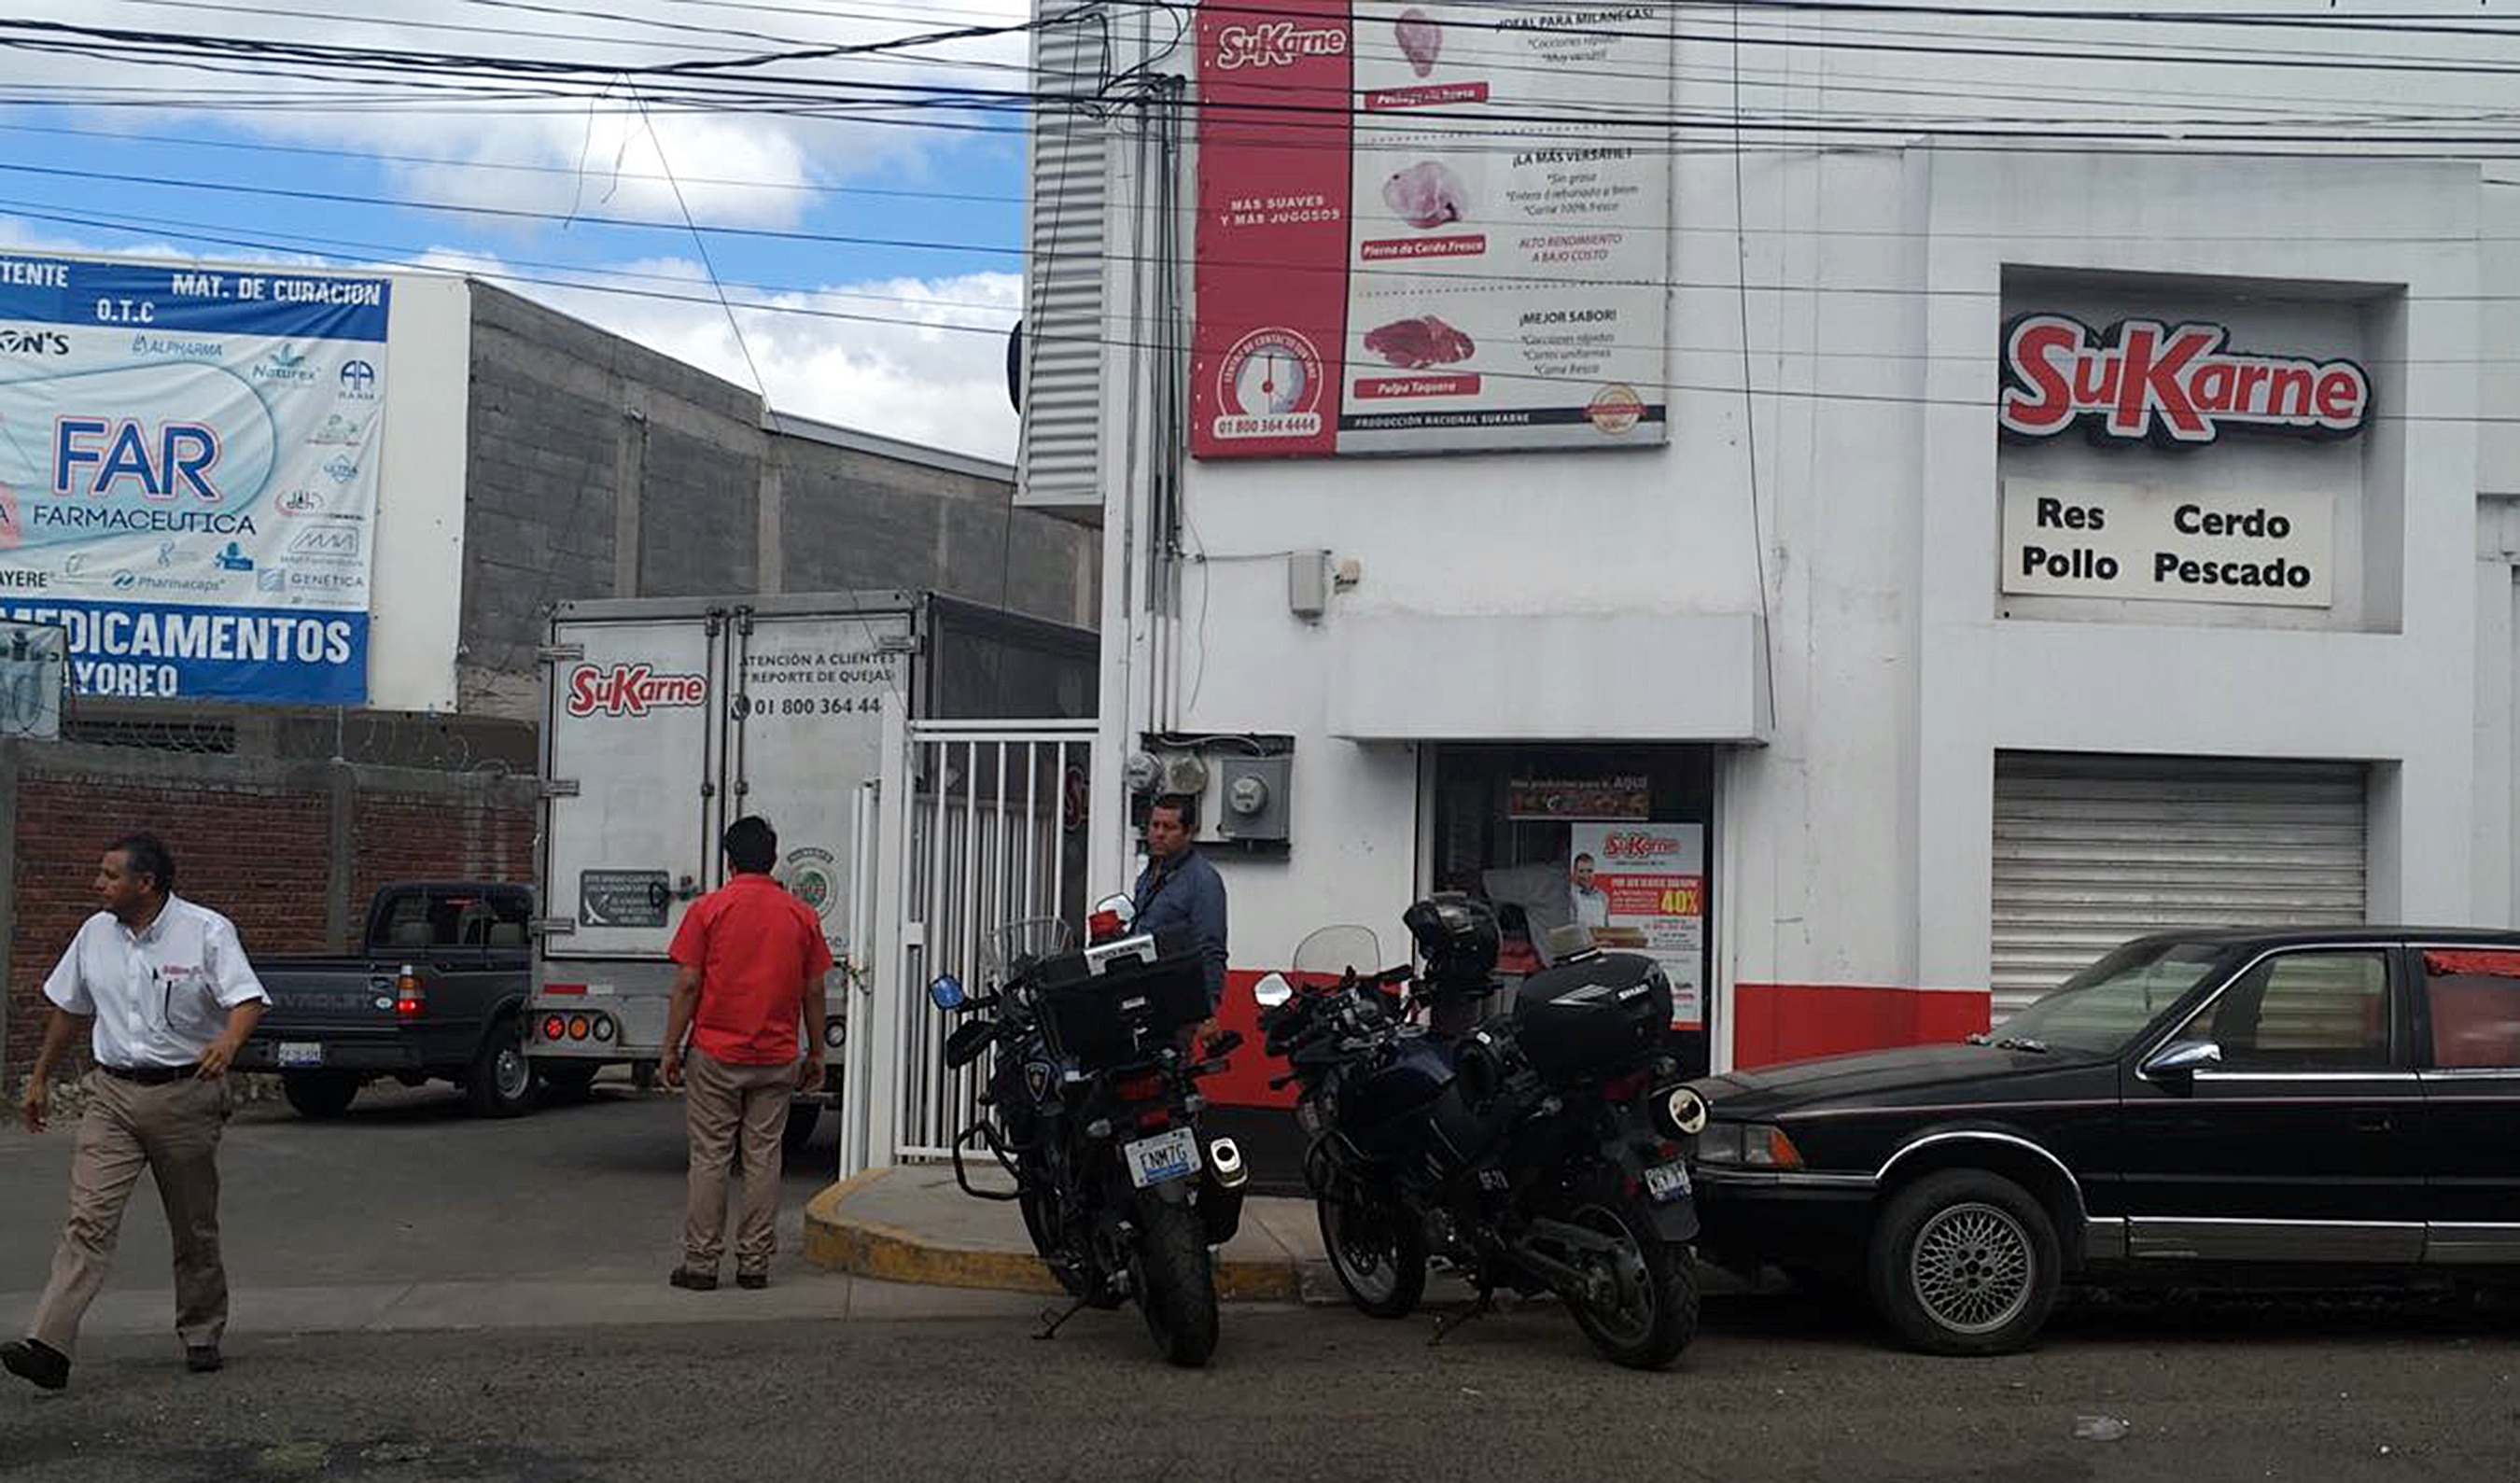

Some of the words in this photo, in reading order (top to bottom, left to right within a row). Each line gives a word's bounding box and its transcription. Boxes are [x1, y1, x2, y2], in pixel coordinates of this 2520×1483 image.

[1217, 22, 1347, 69] SuKarne
[1267, 194, 1323, 209] SUAVES
[1269, 209, 1340, 224] JUGOSOS
[0, 261, 69, 287] TENTE
[172, 273, 230, 298] MAT.
[238, 278, 266, 300] DE
[96, 298, 155, 323] O.T.C
[2000, 315, 2371, 441] SuKarne
[1218, 421, 1232, 434] 01
[54, 416, 220, 501] FAR
[34, 504, 257, 537] FARMACEUTICA
[2037, 497, 2105, 530] Res
[2174, 505, 2291, 539] Cerdo
[2023, 546, 2119, 581] Pollo
[2154, 553, 2311, 589] Pescado
[0, 609, 350, 665] DICAMENTOS
[816, 655, 825, 665] A
[830, 653, 896, 665] CLIENTES
[63, 660, 177, 697] YOREO
[567, 664, 707, 718] SuKarne
[751, 671, 814, 683] REPORTE
[818, 671, 836, 682] DE
[755, 699, 775, 715] 01
[782, 699, 815, 715] 800
[820, 698, 852, 714] 364
